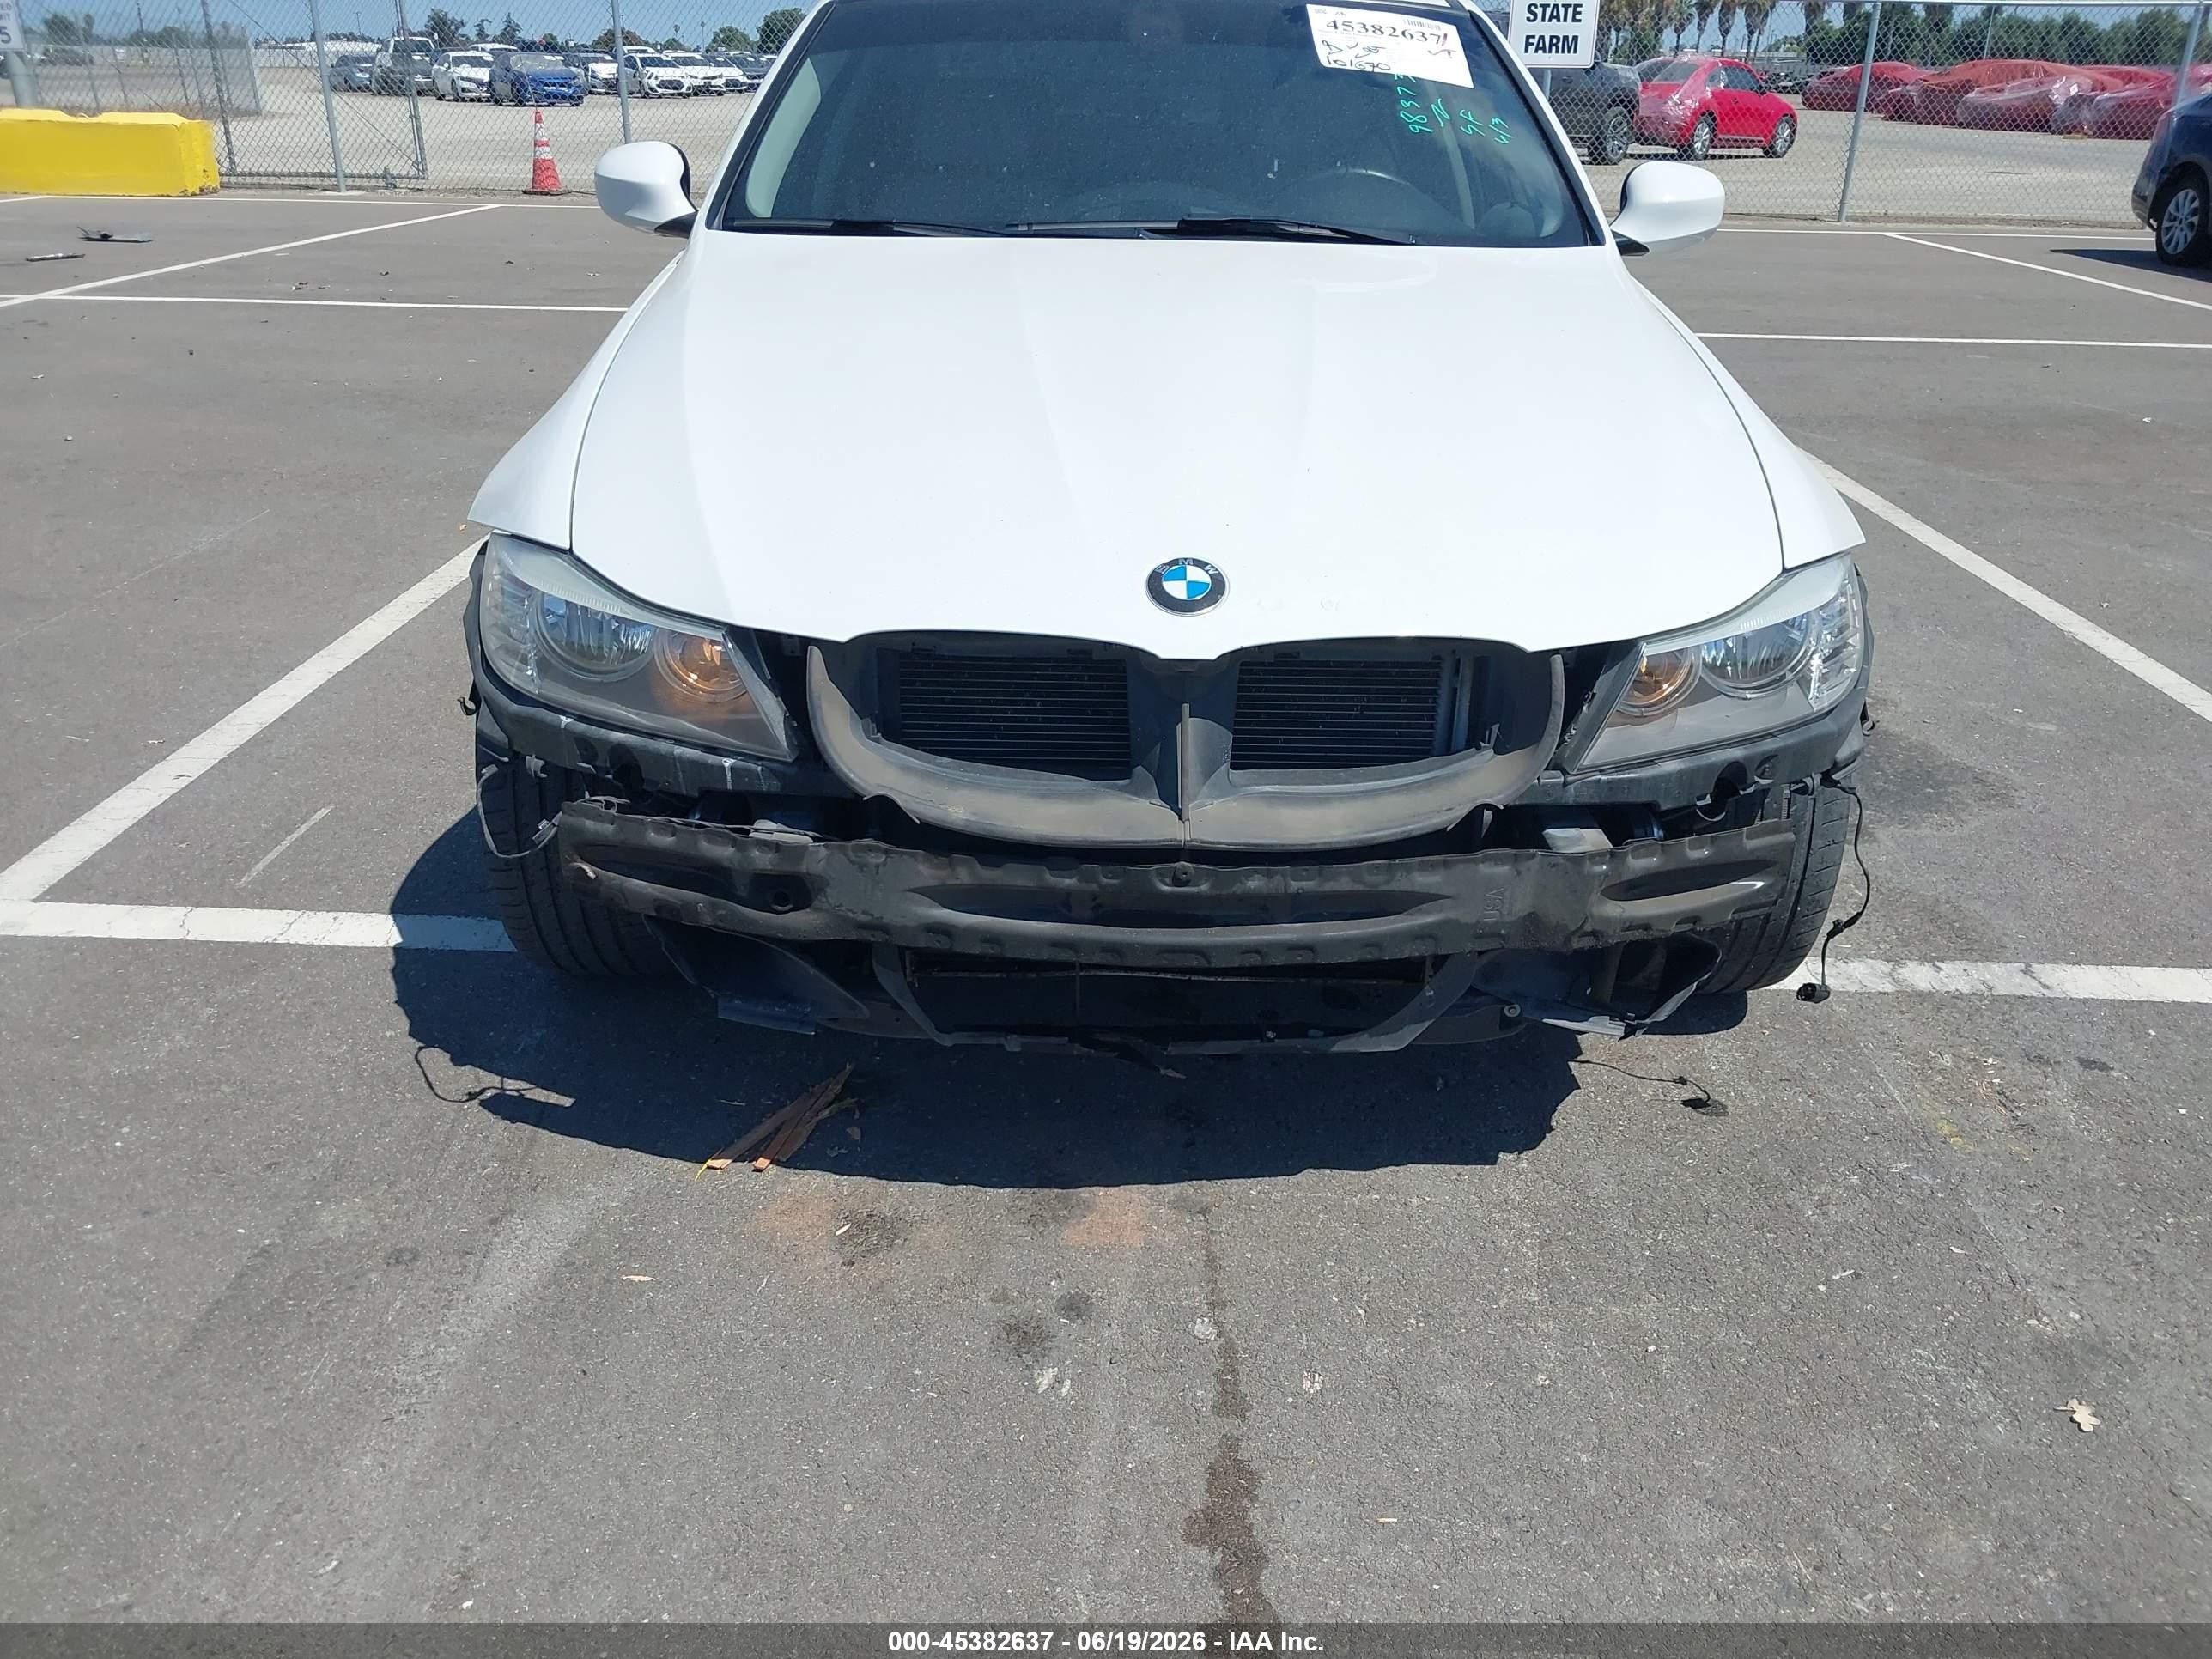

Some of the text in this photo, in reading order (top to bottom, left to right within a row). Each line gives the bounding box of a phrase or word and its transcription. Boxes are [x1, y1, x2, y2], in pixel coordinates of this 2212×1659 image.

[1526, 3, 1583, 23] STATE
[1524, 34, 1579, 54] FARM
[1154, 558, 1219, 574] BMW
